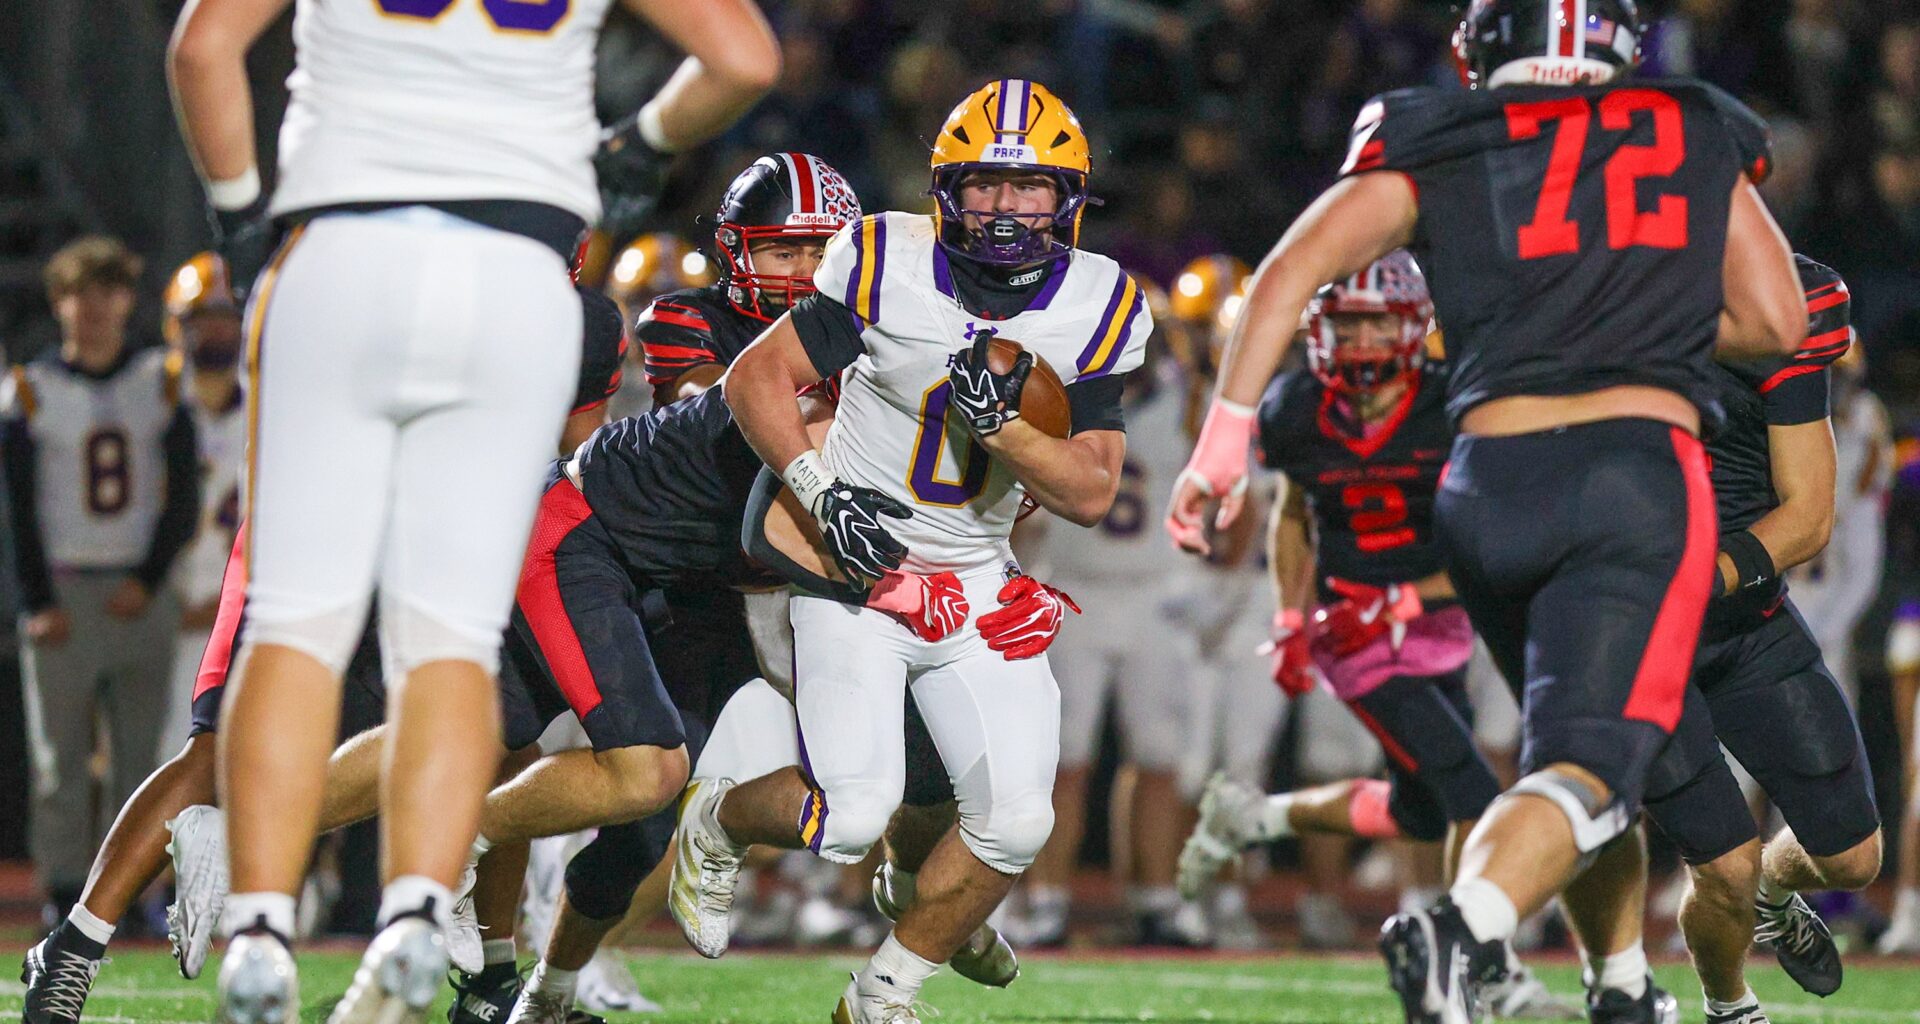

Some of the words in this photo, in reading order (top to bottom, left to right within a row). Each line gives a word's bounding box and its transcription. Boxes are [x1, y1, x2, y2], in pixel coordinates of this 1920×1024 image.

[993, 147, 1024, 159] PREP
[1504, 89, 1689, 260] 72
[791, 214, 831, 224] Riddell
[85, 429, 129, 516] 8
[905, 375, 993, 509] 0
[1342, 482, 1417, 552] 2
[461, 993, 500, 1022] NIKE
